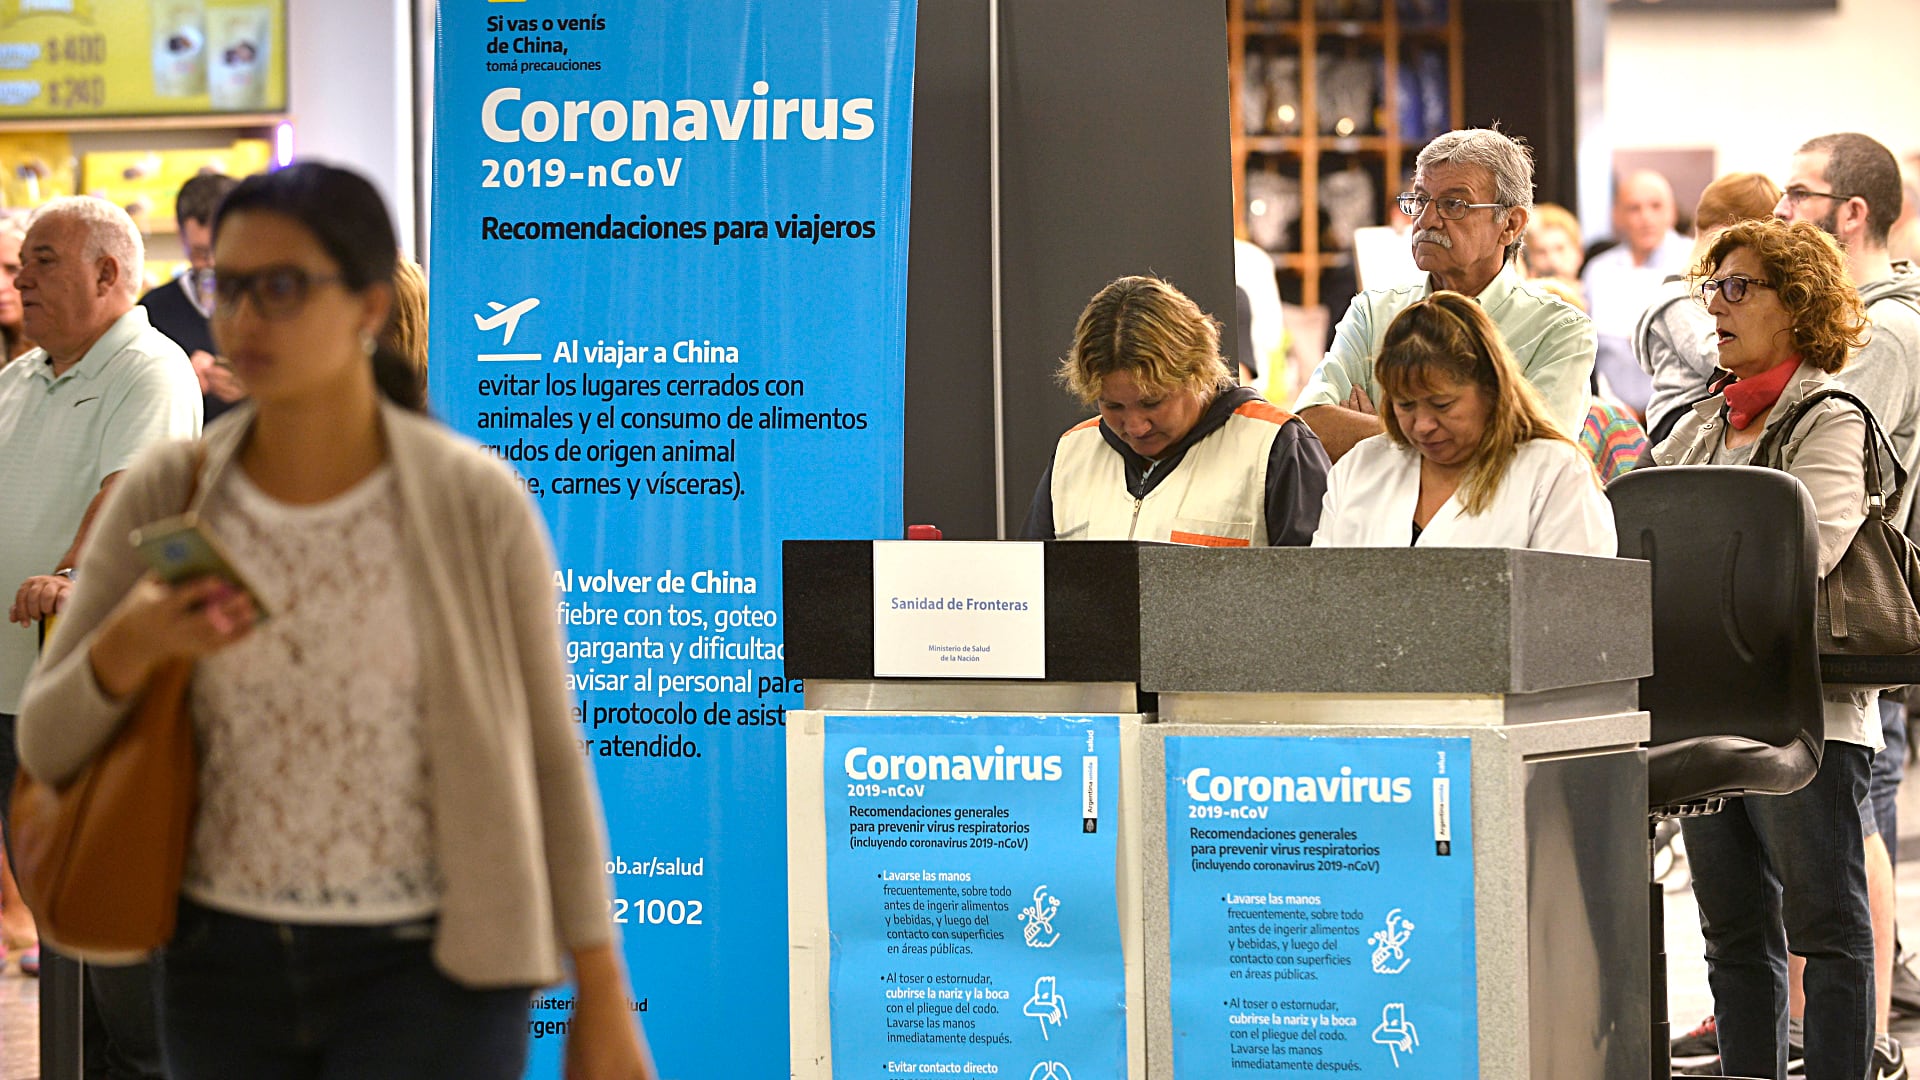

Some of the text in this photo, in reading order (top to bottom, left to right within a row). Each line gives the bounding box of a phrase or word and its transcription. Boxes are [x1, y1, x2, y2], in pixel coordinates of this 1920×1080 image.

[487, 14, 605, 32] Si vas o venís
[487, 36, 568, 55] de China,
[486, 59, 601, 74] tomá precauciones
[482, 81, 874, 142] Coronavirus
[482, 158, 682, 187] 2019-nCoV
[482, 214, 875, 245] Recomendaciones para viajeros
[553, 340, 738, 368] Al viajar a China
[479, 373, 803, 402] evitar los lugares cerrados con
[478, 406, 867, 434] animales y el consumo de alimentos
[555, 438, 581, 461] de
[587, 439, 655, 467] origen
[662, 439, 734, 462] animal
[514, 471, 744, 500] he, carnes y vísceras).
[553, 569, 756, 594] Al volver de China
[892, 598, 1028, 610] Sanidad de Fronteras
[555, 602, 776, 632] fiebre con tos, goteo
[566, 637, 664, 664] garganta
[670, 642, 684, 664] y
[565, 668, 804, 698] avisar al personal para
[594, 702, 697, 729] protocolo
[704, 702, 730, 725] de
[737, 704, 786, 726] asist
[576, 734, 701, 757] er atendido.
[845, 745, 1062, 780] Coronavirus
[848, 784, 924, 796] 2019-nCoV
[1187, 766, 1411, 802] Coronavirus
[850, 805, 1009, 820] Recomendaciones generales
[1189, 806, 1268, 818] 2019-nCoV
[850, 821, 1029, 835] para prevenir virus respiratorios
[1190, 827, 1357, 842] Recomendaciones generales
[850, 836, 1028, 850] (incluyendo coronavirus 2019-nCoV)
[1192, 843, 1380, 858] para prevenir virus respiratorios
[605, 856, 704, 877] ob.ar/salud
[1192, 859, 1379, 873] (incluyendo coronavirus 2019-nCoV)
[884, 870, 970, 881] Lavarse las manos
[884, 884, 1011, 897] frecuentemente, sobre todo
[1227, 893, 1321, 904] Lavarse las manos
[607, 899, 628, 923] 2
[884, 900, 1008, 913] antes de ingerir alimentos
[885, 914, 988, 927] y bebidas, y luego del
[887, 930, 929, 938] contacto
[951, 929, 1004, 941] superficies
[902, 943, 927, 954] áreas
[930, 943, 972, 956] públicas.
[887, 972, 896, 983] Al
[900, 974, 924, 983] toser
[936, 973, 992, 985] estornudar,
[886, 987, 1009, 1001] cubrirse la nariz y la boca
[906, 1002, 914, 1013] el
[918, 1002, 952, 1016] pliegue
[956, 1002, 969, 1013] del
[973, 1003, 998, 1013] codo.
[1230, 998, 1240, 1008] Al
[1243, 999, 1268, 1009] toser
[1280, 1000, 1338, 1011] estornudar,
[887, 1017, 975, 1028] Lavarse las manos
[888, 1032, 1012, 1046] inmediatamente después.
[888, 1062, 998, 1073] Evitar contacto directo
